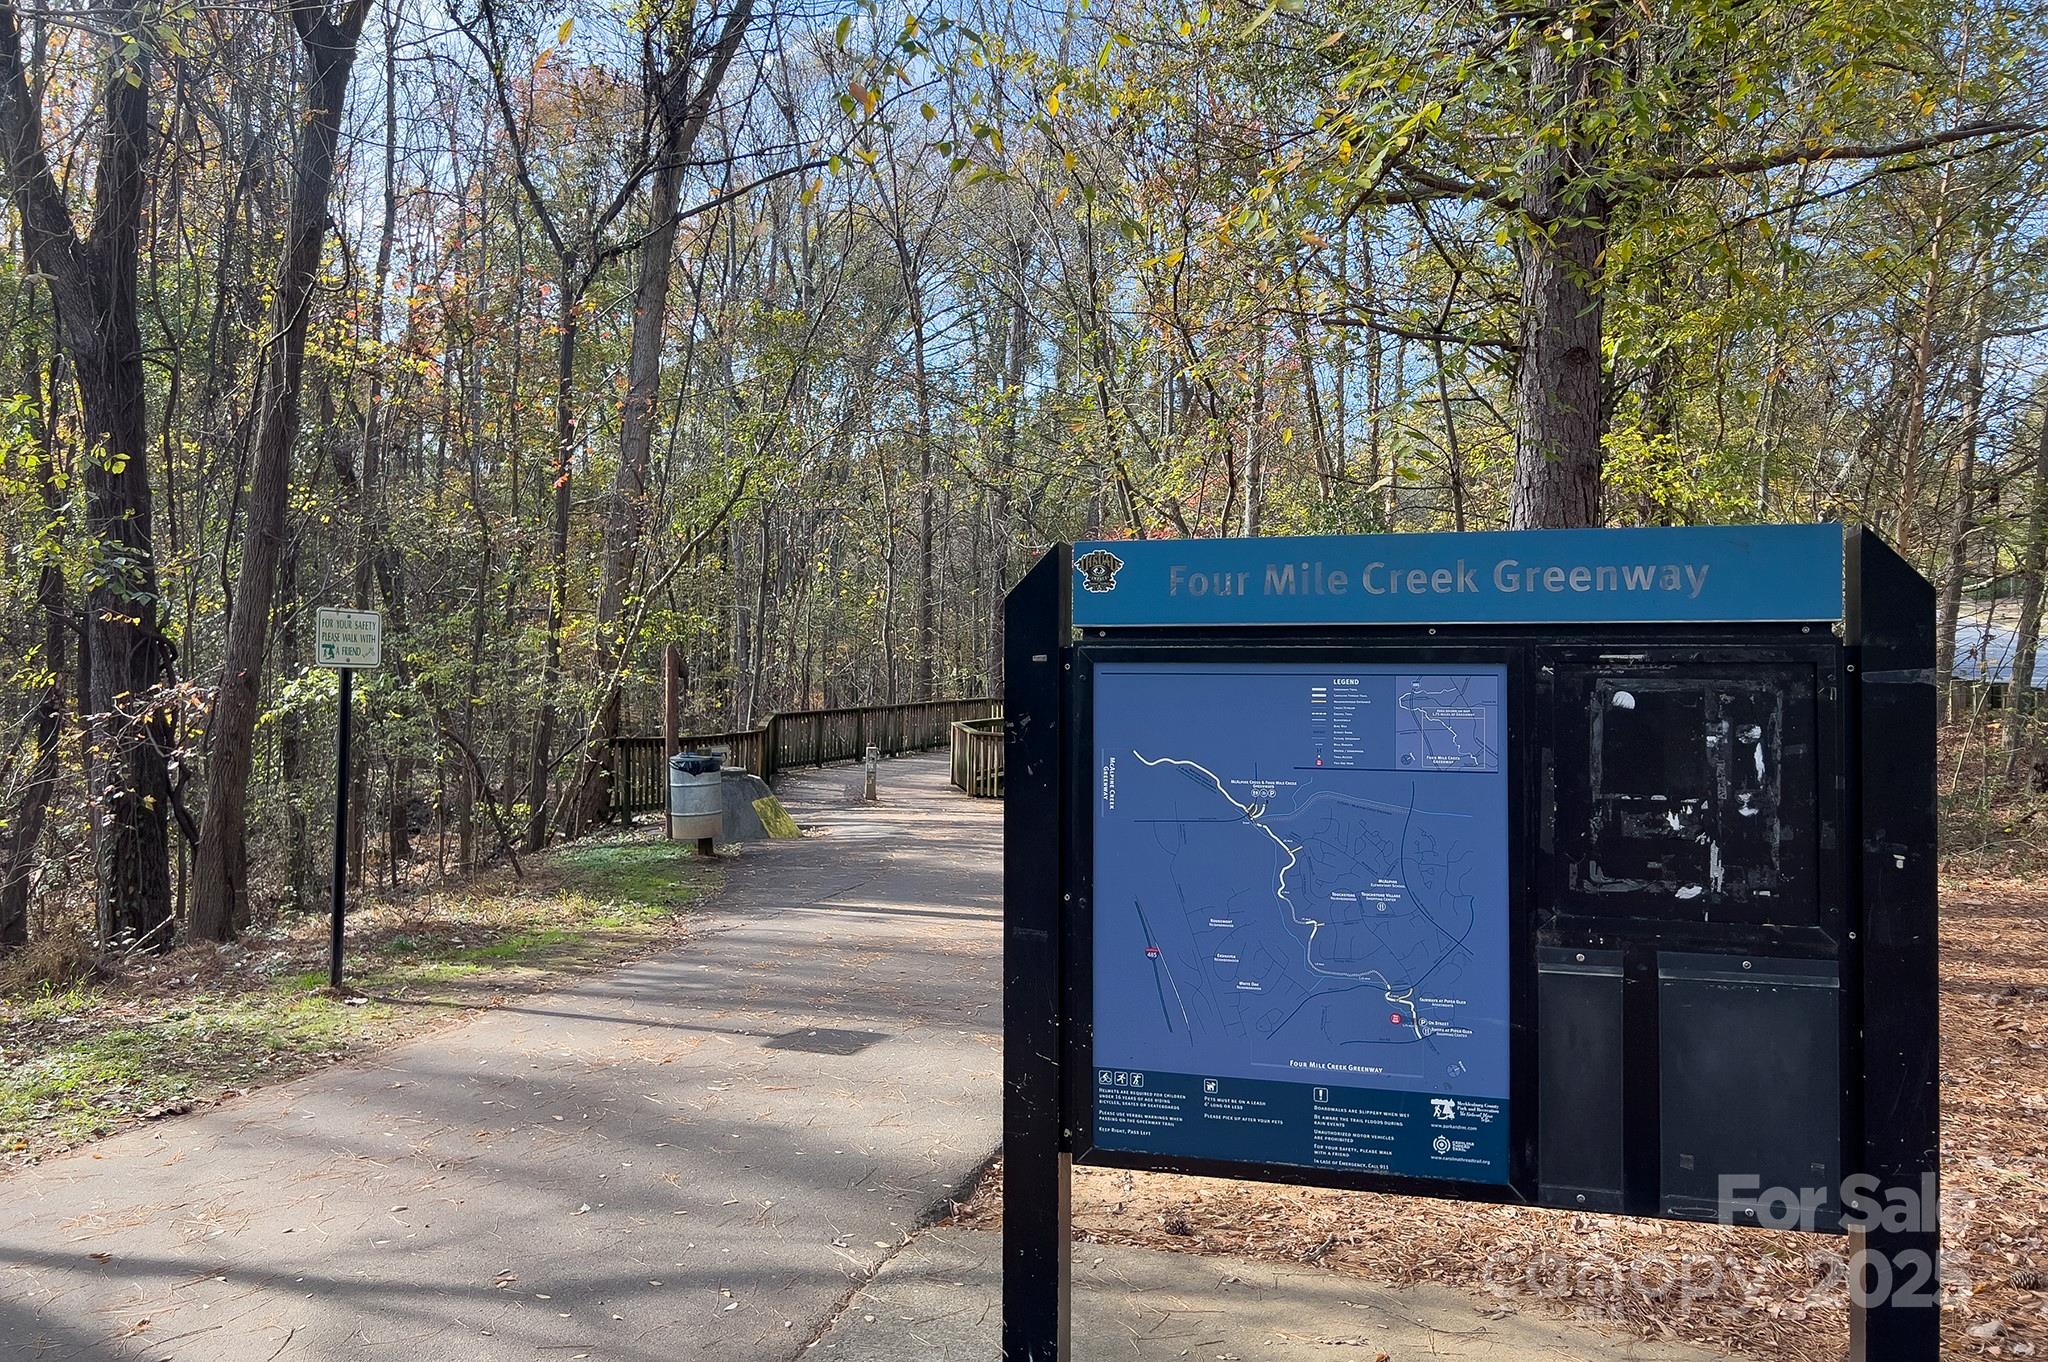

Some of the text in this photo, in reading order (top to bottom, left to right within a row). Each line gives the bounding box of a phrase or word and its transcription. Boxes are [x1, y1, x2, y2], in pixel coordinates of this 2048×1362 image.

[1169, 559, 1709, 599] Four Mile Creek Greenway
[321, 618, 376, 631] FOR YOUR SAFETY
[321, 632, 376, 643] PLEASE WALK WITH
[341, 646, 361, 656] FRIEND
[1290, 1059, 1383, 1073] FOUR MILE CREEK GREENWAY
